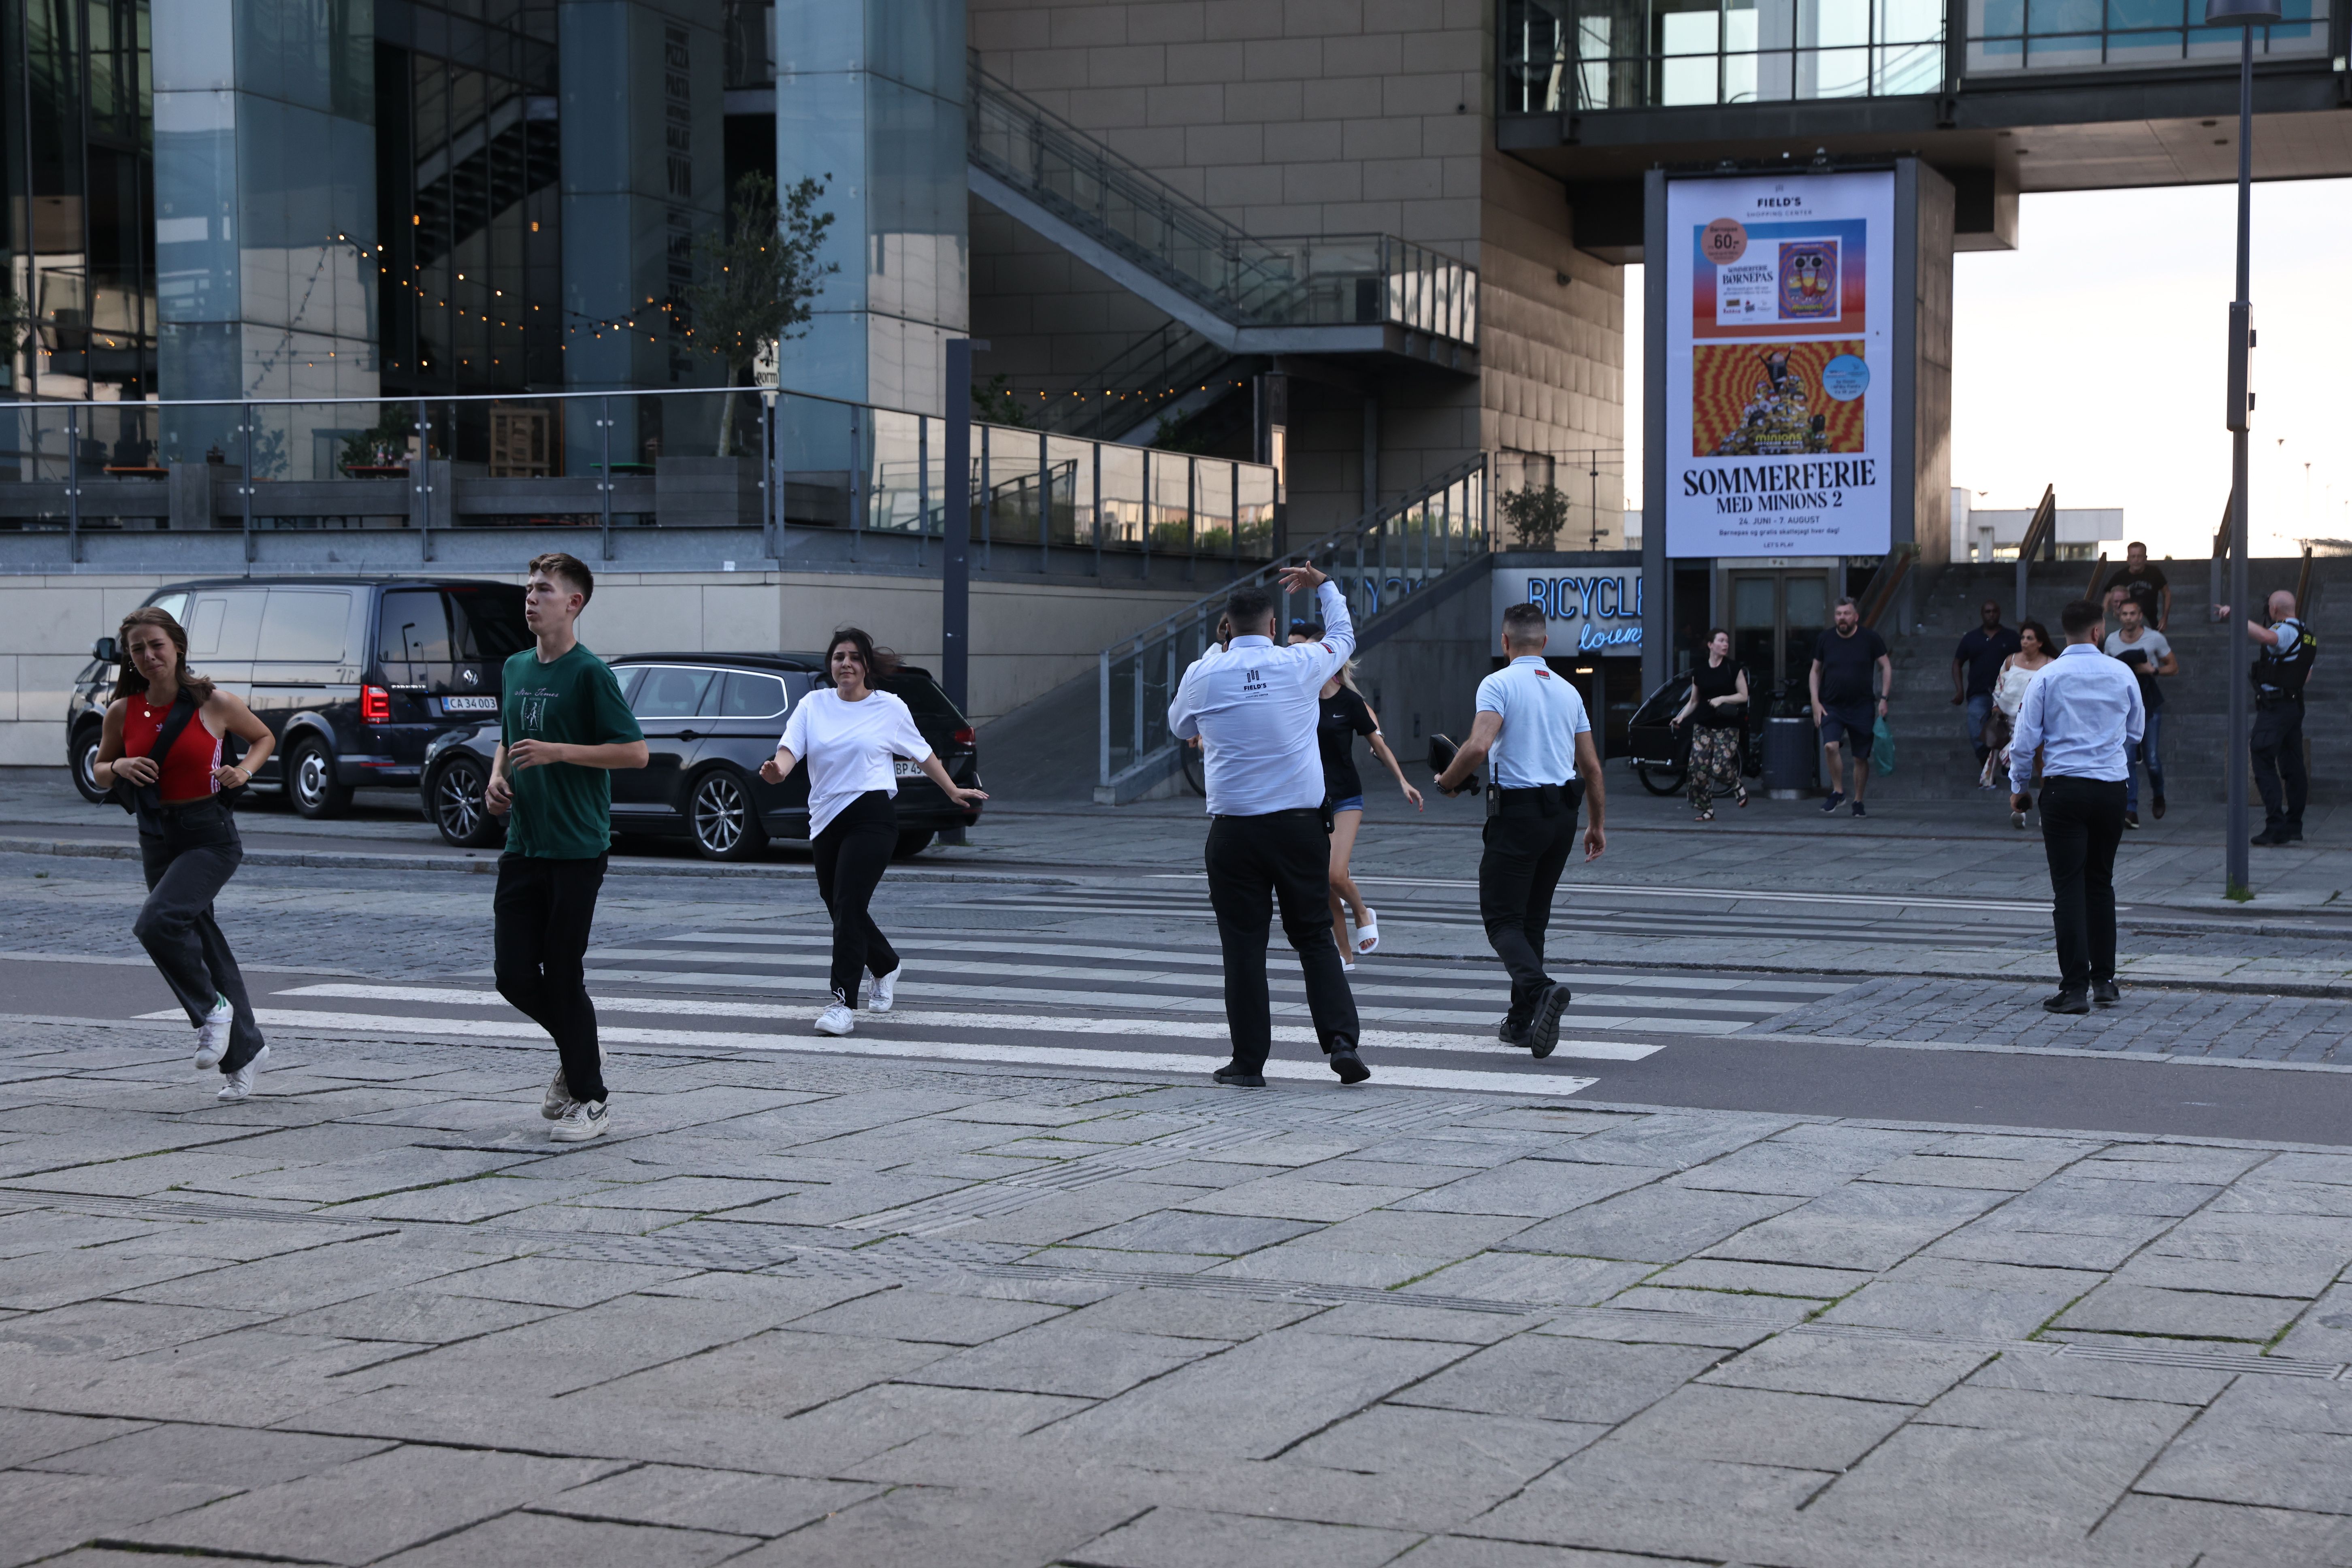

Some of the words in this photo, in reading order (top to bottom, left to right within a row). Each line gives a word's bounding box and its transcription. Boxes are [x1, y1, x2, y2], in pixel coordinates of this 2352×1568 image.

[1758, 197, 1801, 207] FIELD'S
[1683, 458, 1876, 496] SOMMERFERIE
[1717, 496, 1753, 514] MED
[1758, 491, 1828, 512] MINIONS
[1832, 490, 1842, 507] 2
[1753, 517, 1771, 525] JUNI
[1787, 515, 1820, 524] AUGUST
[451, 699, 463, 708] CA
[465, 699, 477, 708] 34
[479, 699, 496, 708] 003
[896, 763, 908, 774] BP
